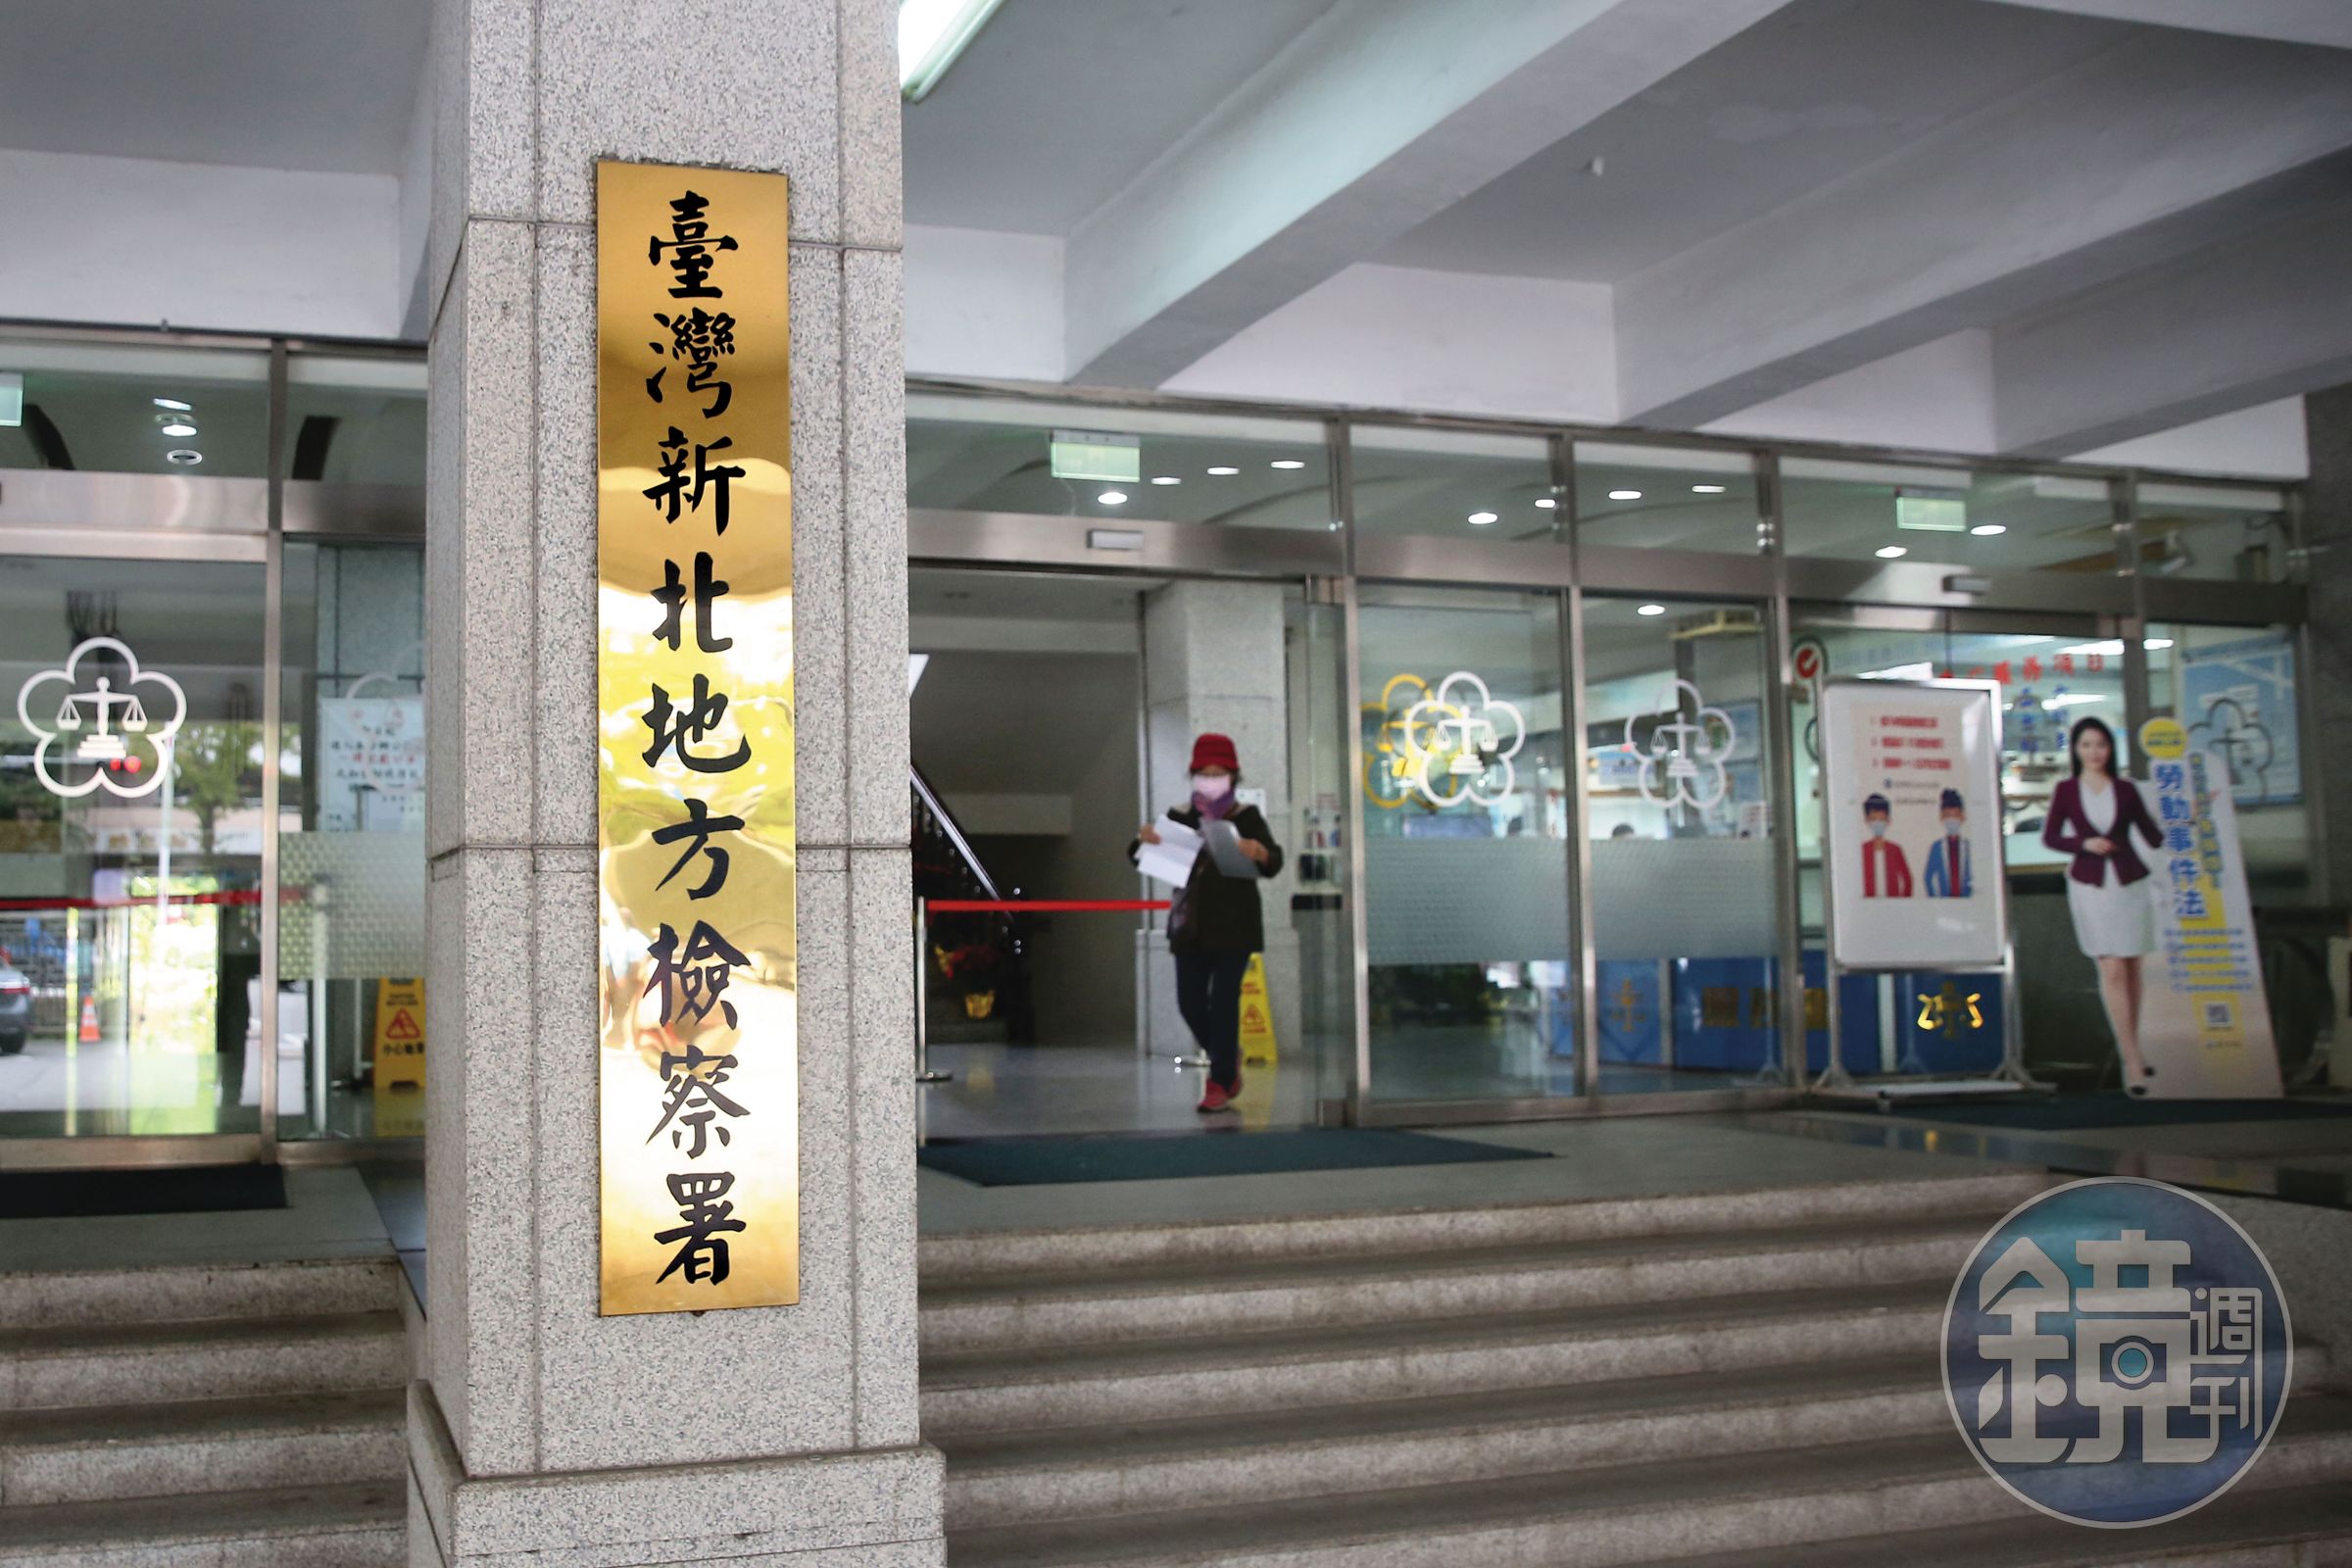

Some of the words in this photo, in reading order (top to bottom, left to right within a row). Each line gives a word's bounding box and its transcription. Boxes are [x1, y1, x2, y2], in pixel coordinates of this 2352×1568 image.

[642, 190, 752, 1286] 臺灣新北地方檢察署
[2156, 763, 2208, 918] 勞動事件法
